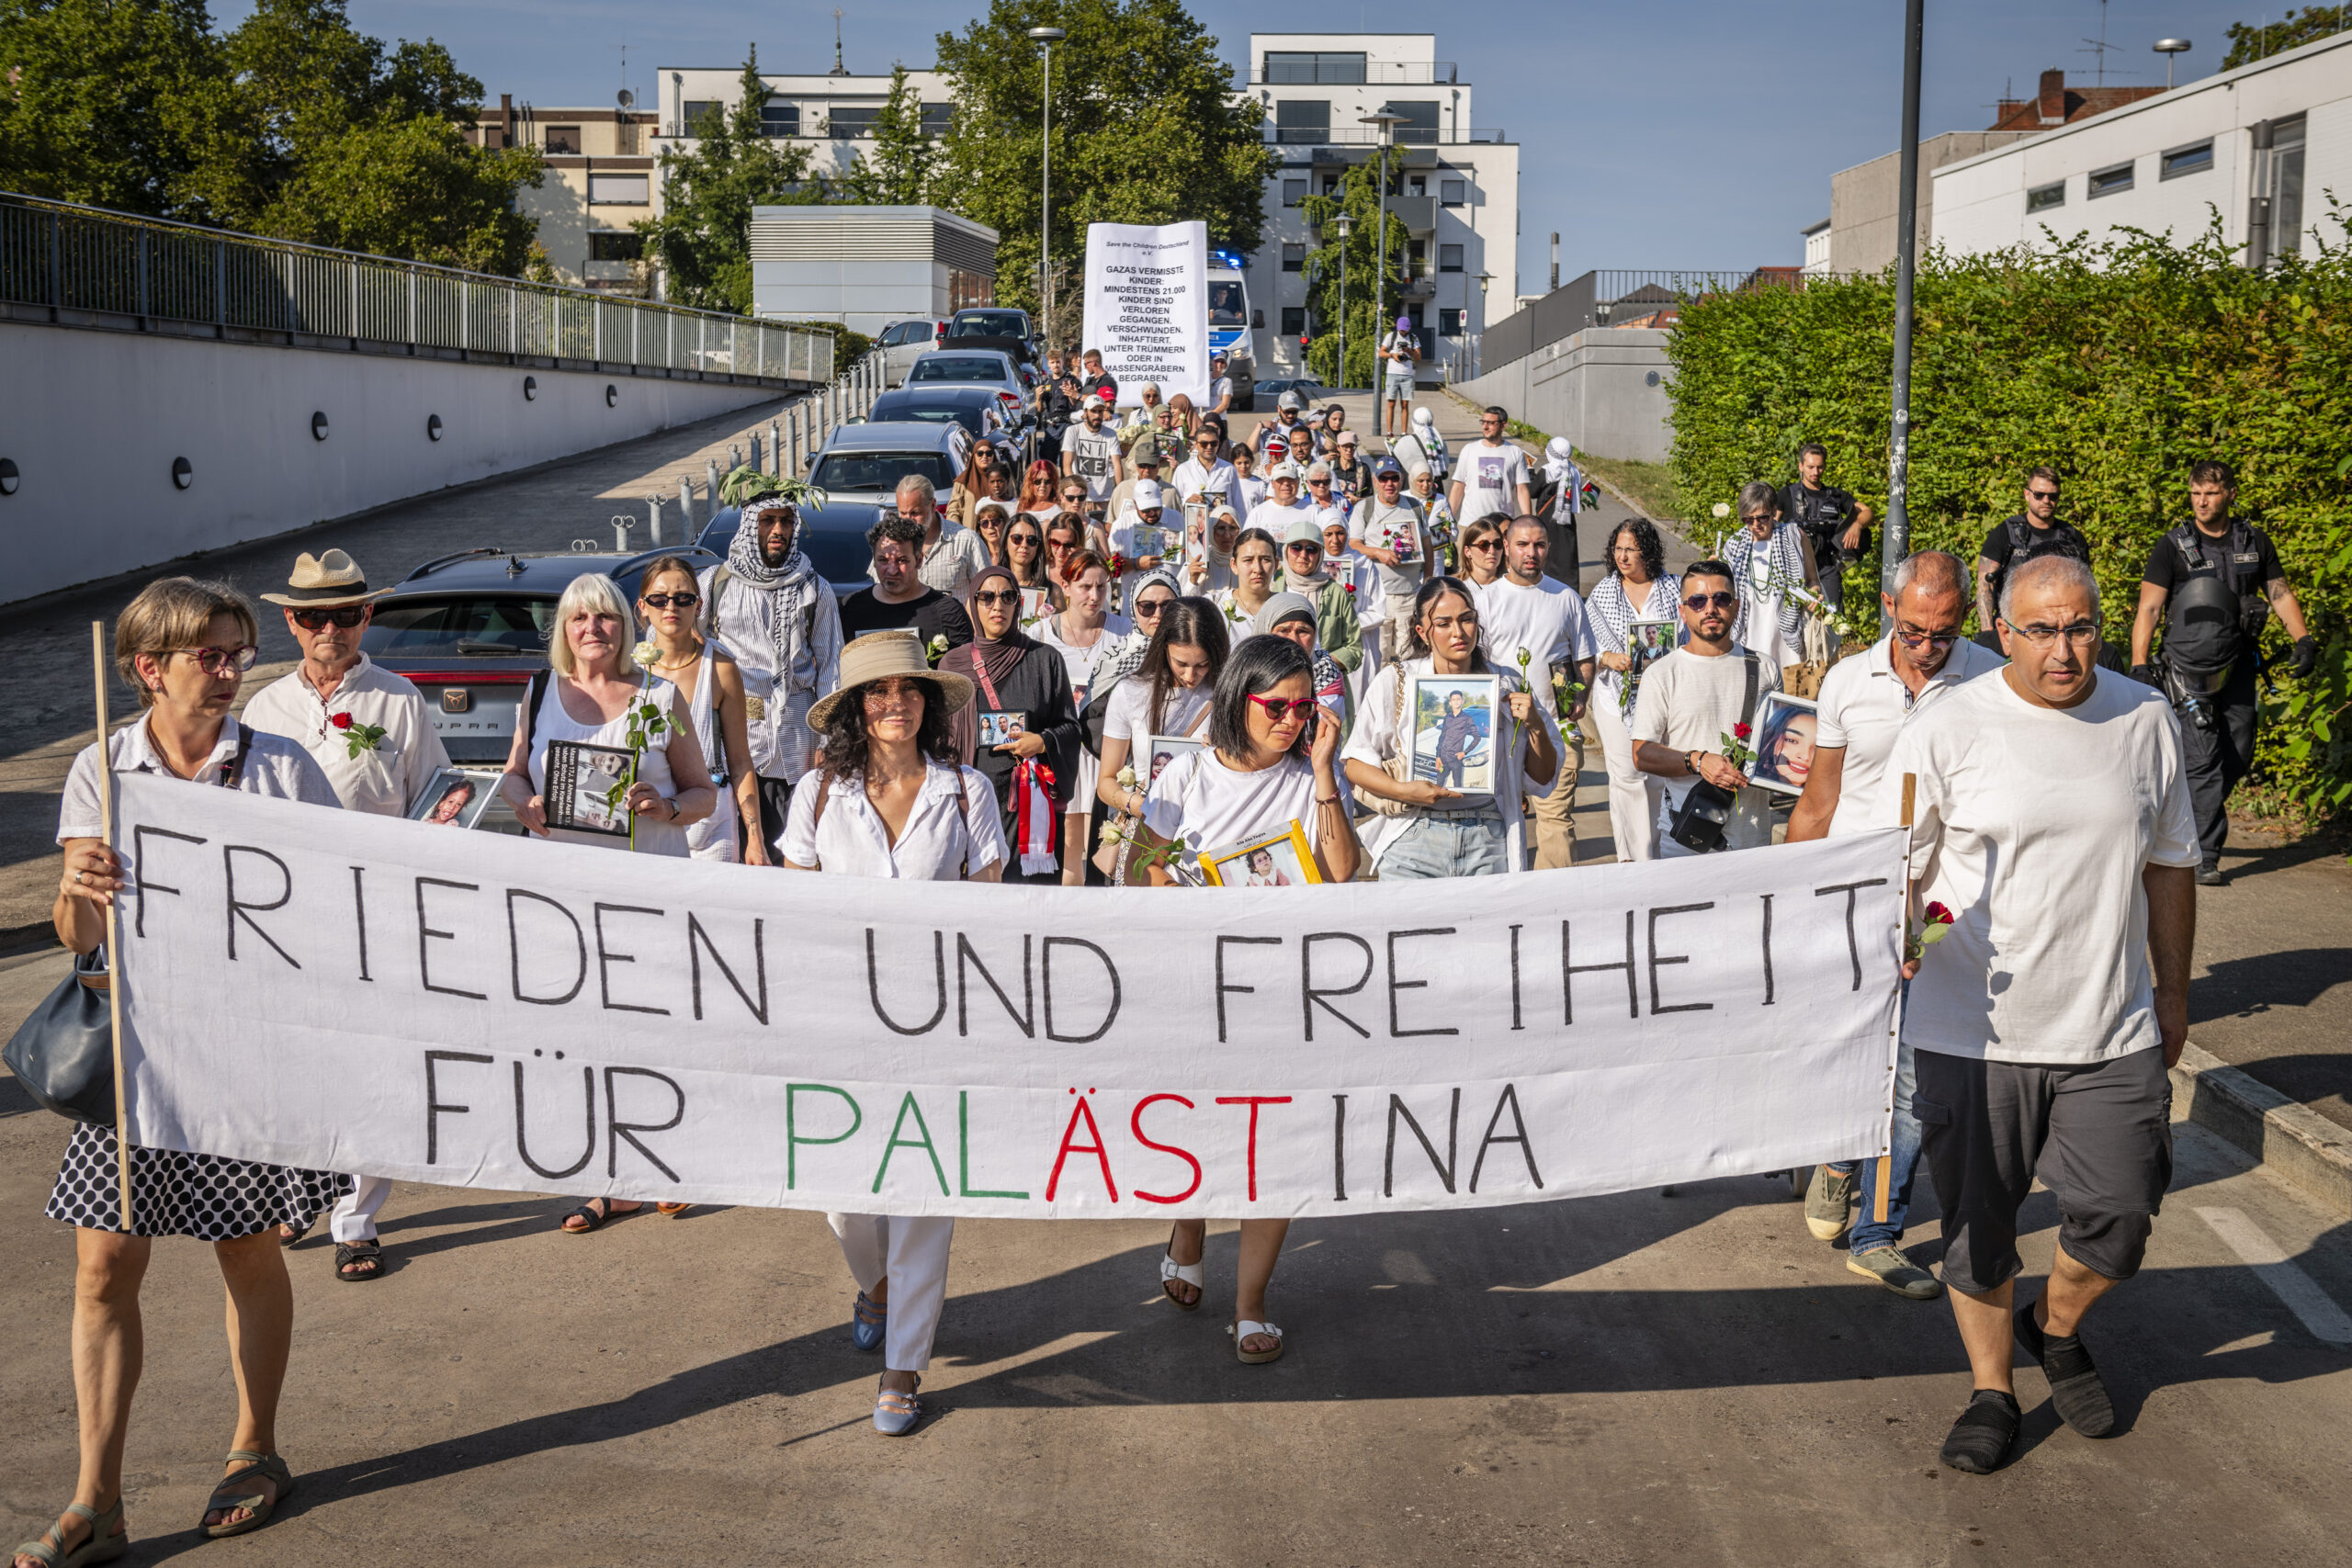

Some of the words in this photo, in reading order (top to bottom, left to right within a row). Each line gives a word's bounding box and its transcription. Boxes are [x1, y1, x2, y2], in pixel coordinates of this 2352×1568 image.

[1159, 240, 1190, 250] Deutschland
[1106, 265, 1136, 274] GAZAS
[1138, 265, 1184, 276] VERMISSTE
[1129, 276, 1165, 286] KINDER:
[1104, 286, 1160, 295] MINDESTENS
[1162, 286, 1185, 295] 21.000
[1118, 296, 1152, 304] KINDER
[1153, 297, 1174, 305] SIND
[1122, 306, 1170, 314] VERLOREN
[1136, 344, 1186, 354] TRÜMMERN
[1118, 374, 1170, 382] BEGRABEN.
[134, 824, 769, 1025] FRIEDEN
[865, 928, 1121, 1043] UND
[1216, 878, 1887, 1043] FREIHEIT
[425, 1050, 684, 1183] FÜR
[786, 1083, 1544, 1204] PALÄSTINA
